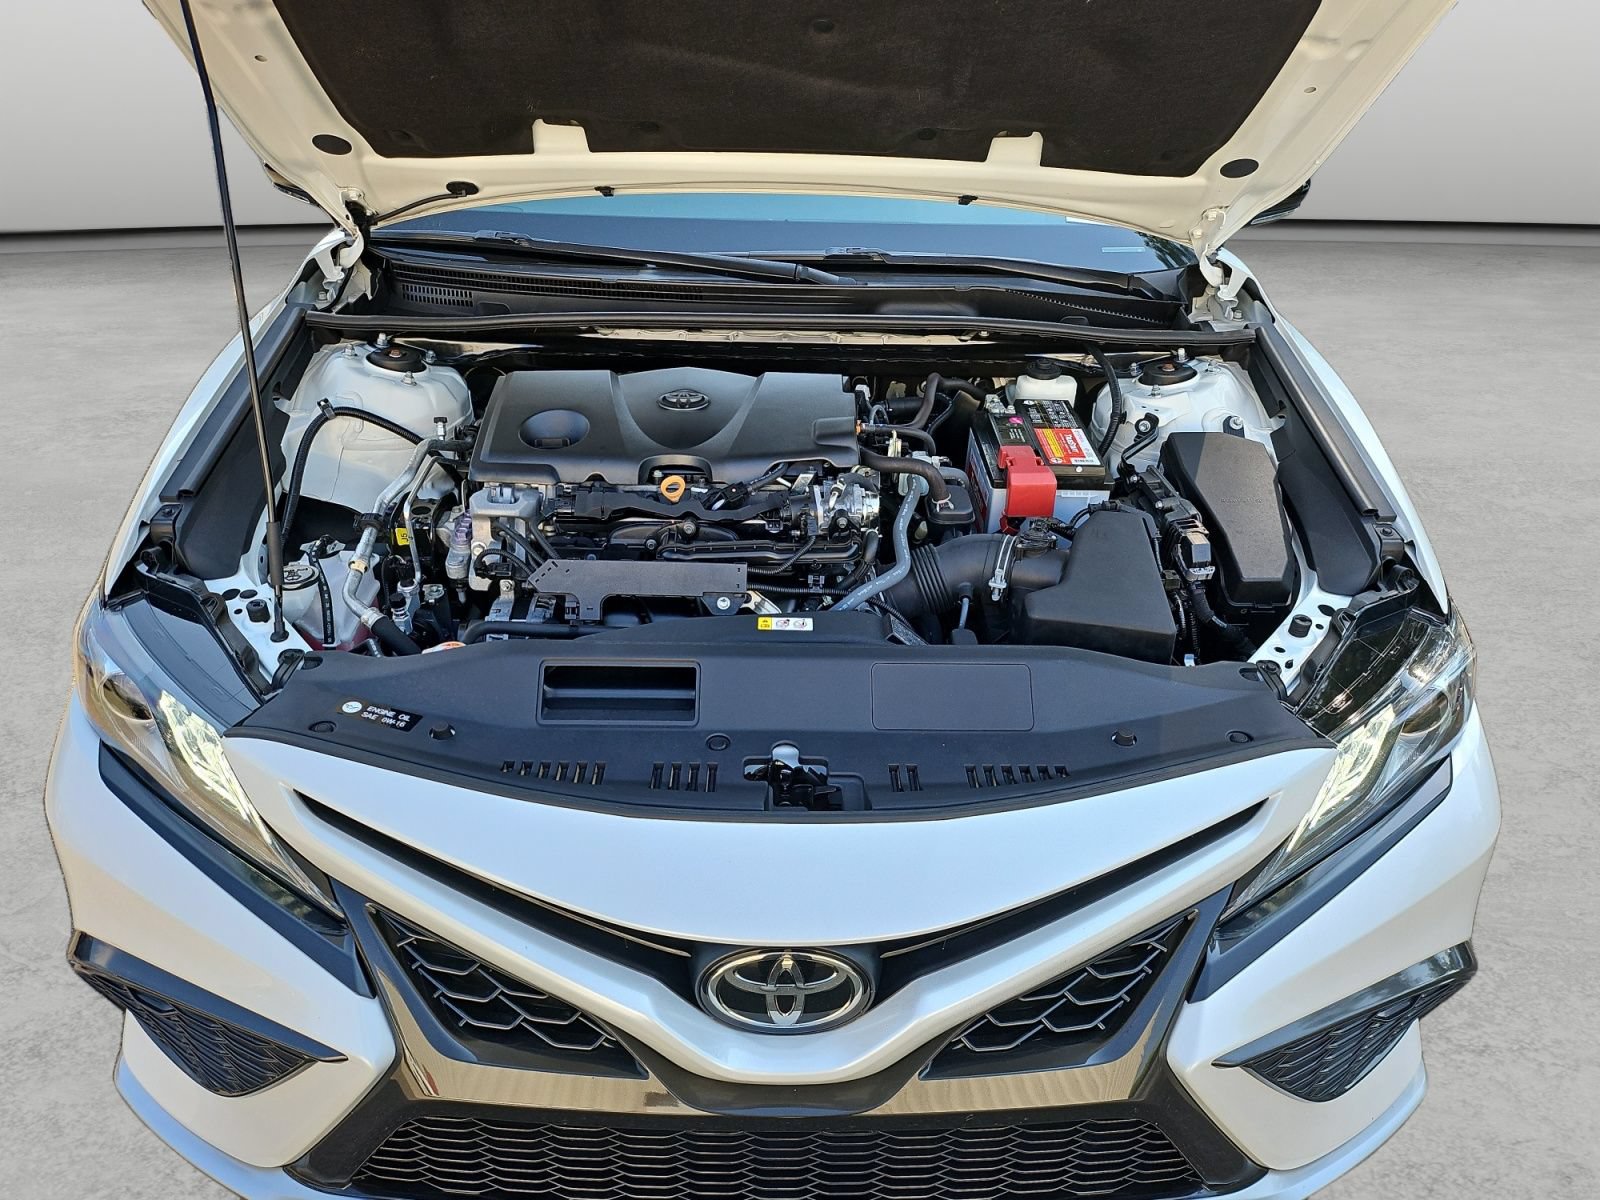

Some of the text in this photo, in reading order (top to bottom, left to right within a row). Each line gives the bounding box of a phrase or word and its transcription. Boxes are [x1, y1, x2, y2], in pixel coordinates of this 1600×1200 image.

[361, 711, 406, 728] SAE 0W-16
[367, 706, 410, 722] ENGINE OIL
